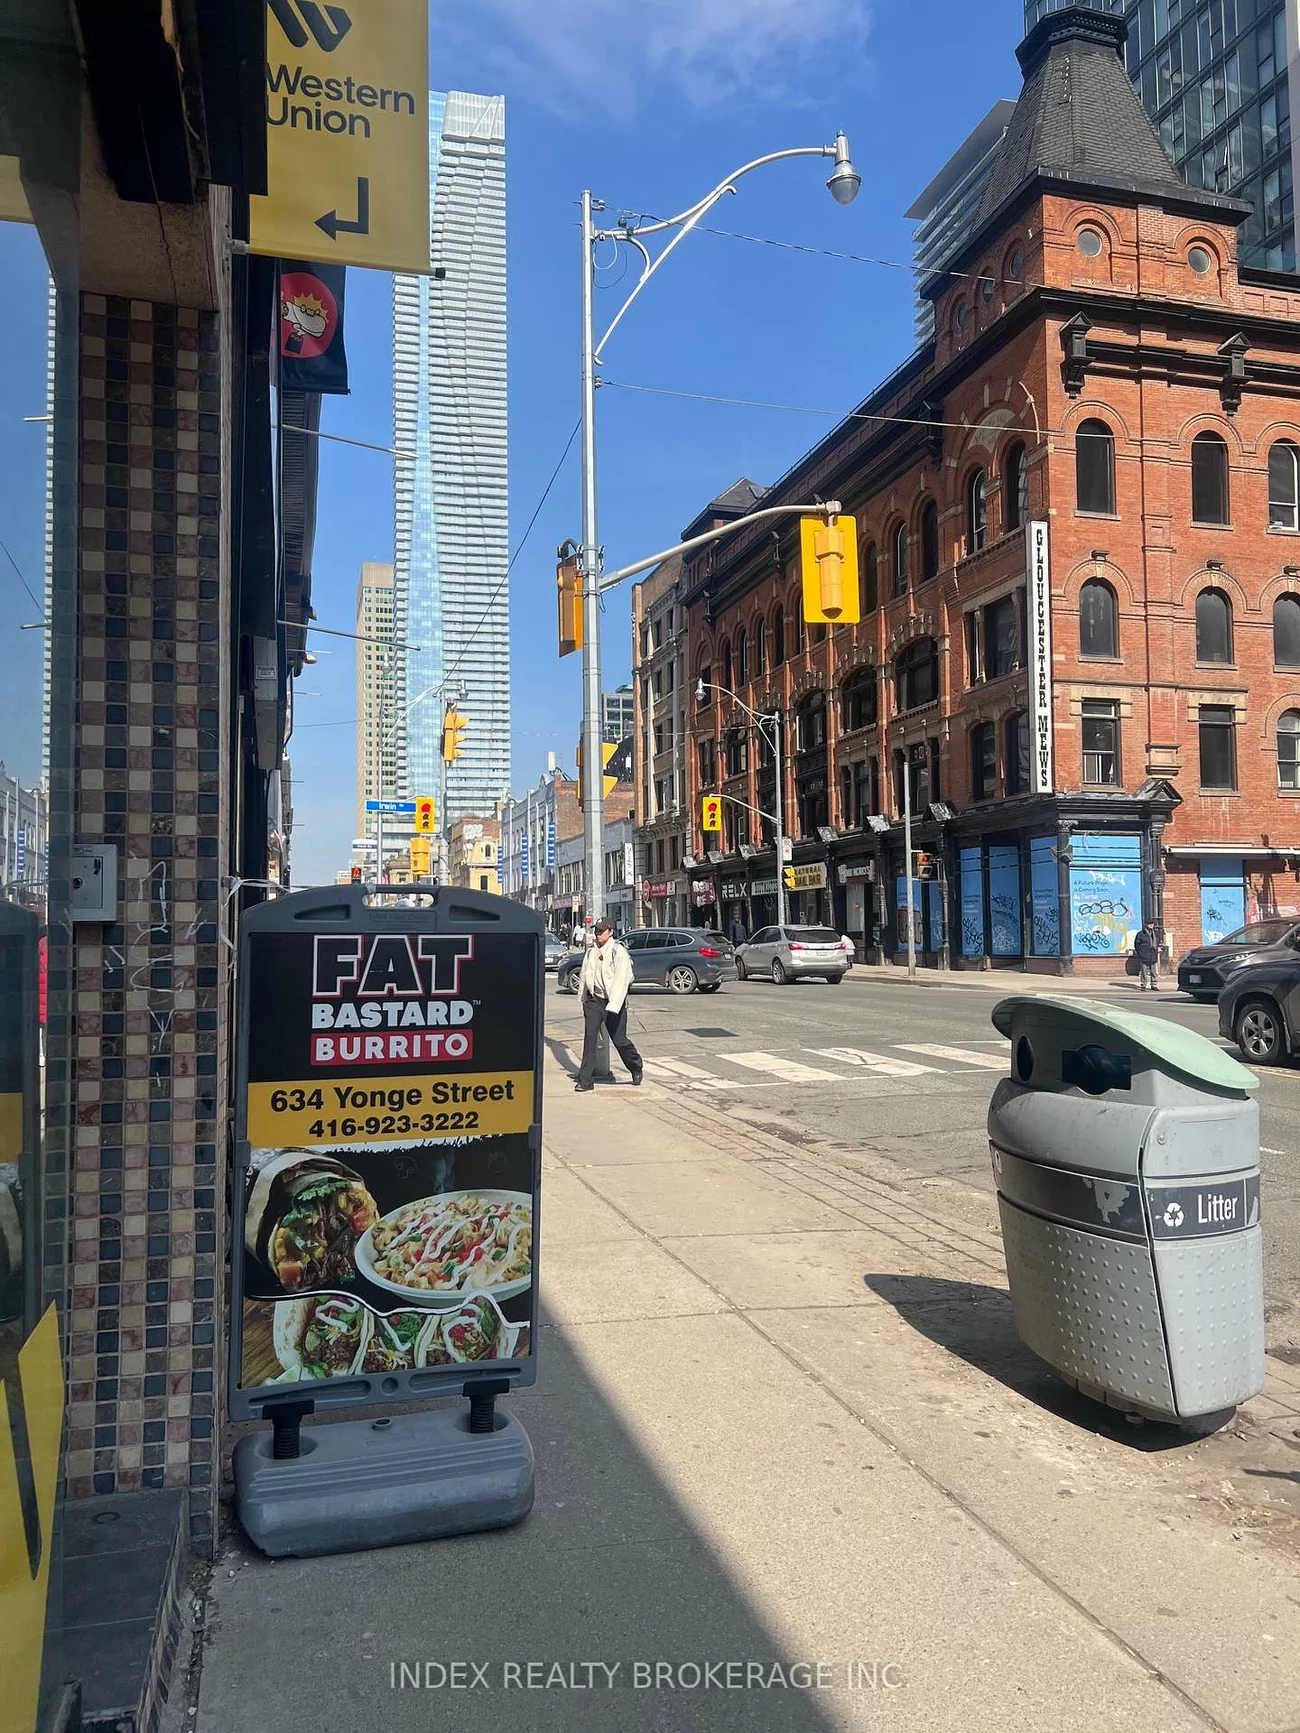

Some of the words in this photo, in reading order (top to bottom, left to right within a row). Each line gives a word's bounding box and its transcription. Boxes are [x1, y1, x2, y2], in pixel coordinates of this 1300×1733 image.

[266, 64, 415, 115] Western
[266, 94, 371, 138] Union
[1036, 528, 1047, 708] GLOUCESTER
[1038, 715, 1048, 787] MEWS
[721, 882, 747, 899] RELX
[312, 935, 474, 997] FAT
[312, 1000, 473, 1028] BASTARD
[315, 1033, 468, 1061] BURRITO
[270, 1089, 324, 1113] 634
[333, 1085, 423, 1112] Yonge
[431, 1080, 515, 1105] Street
[308, 1111, 480, 1138] 416-923-3222
[1198, 1194, 1237, 1223] Litter
